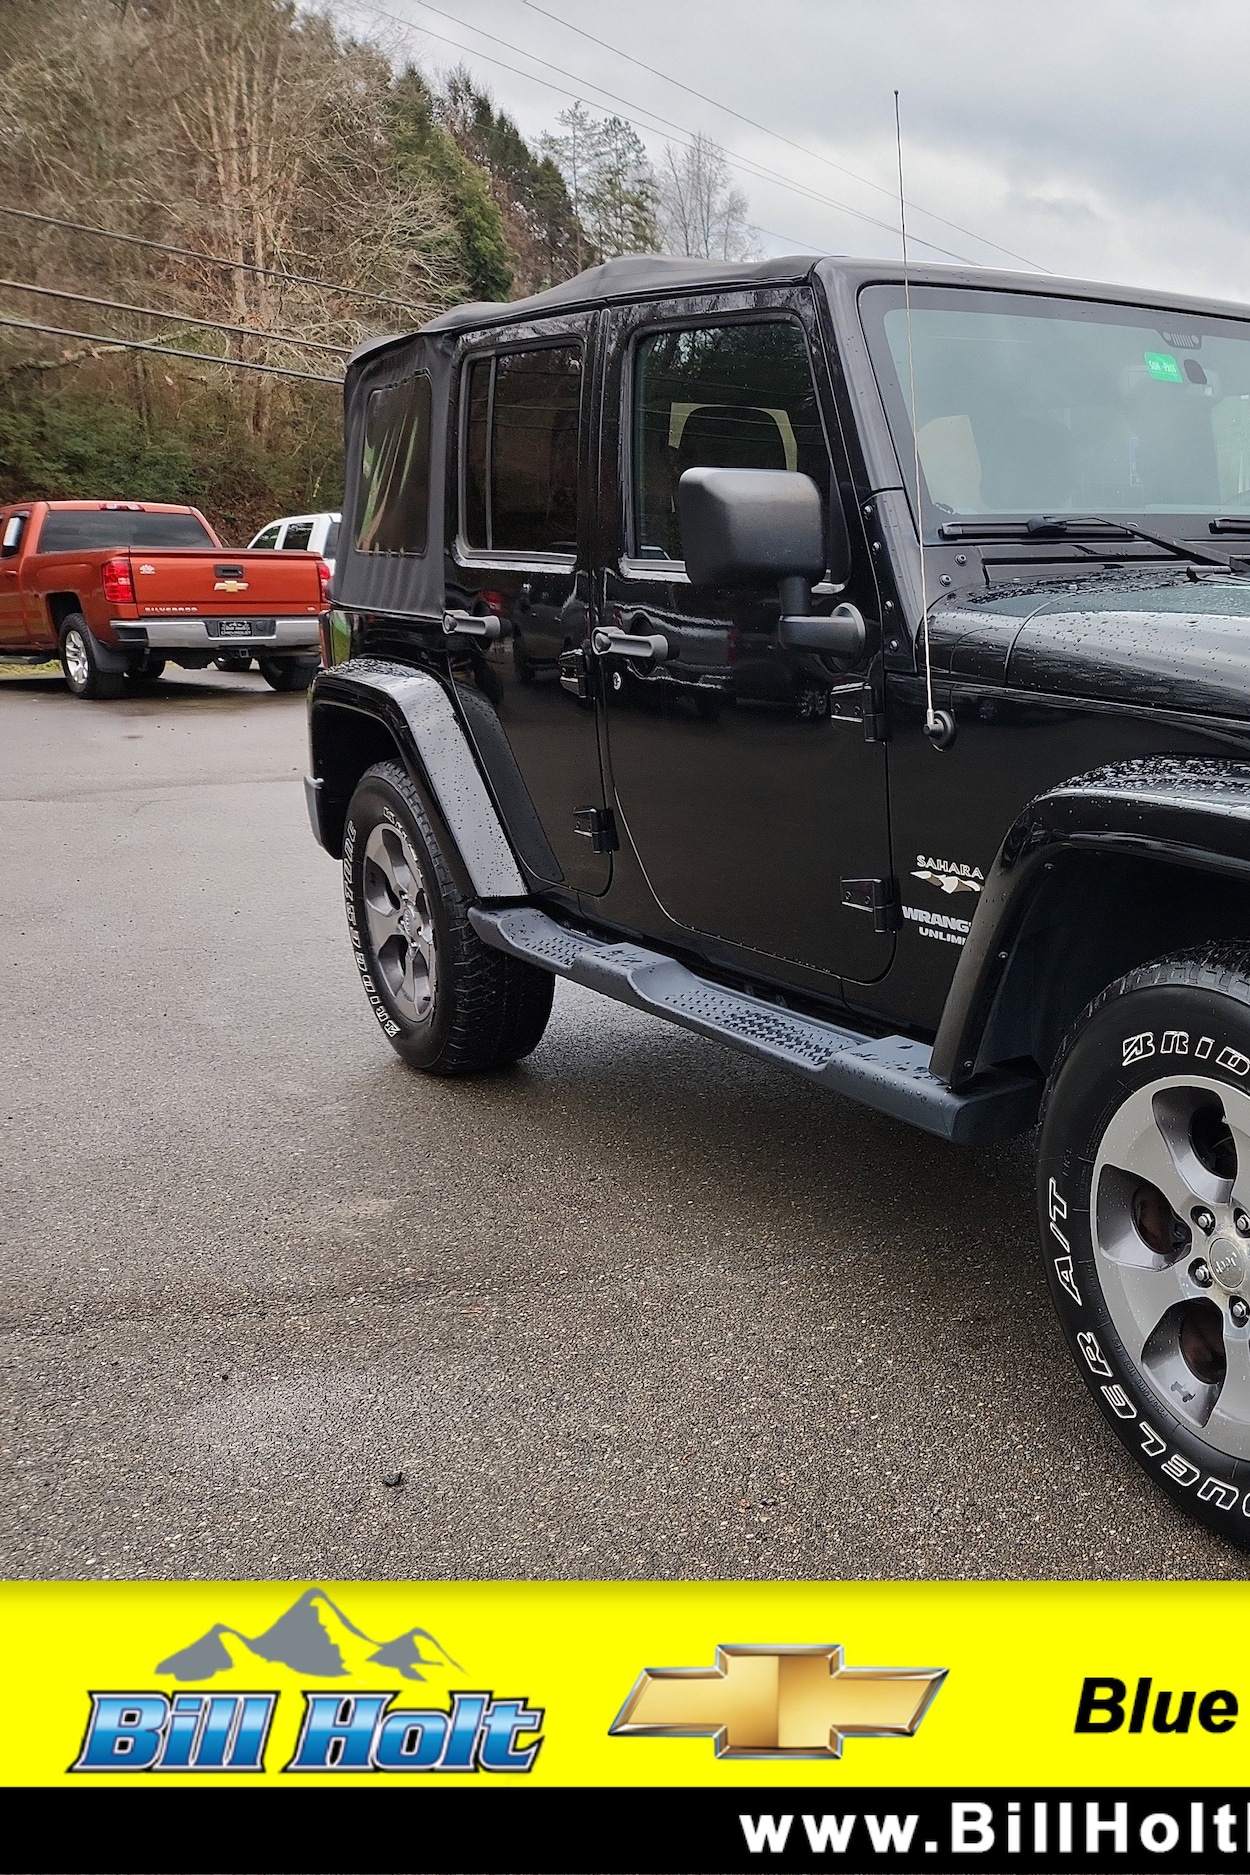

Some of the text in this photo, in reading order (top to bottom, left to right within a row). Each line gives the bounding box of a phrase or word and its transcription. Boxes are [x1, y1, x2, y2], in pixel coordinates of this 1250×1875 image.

[916, 854, 985, 880] SAHARA
[901, 905, 972, 933] WRANG
[1049, 1177, 1083, 1306] A/T
